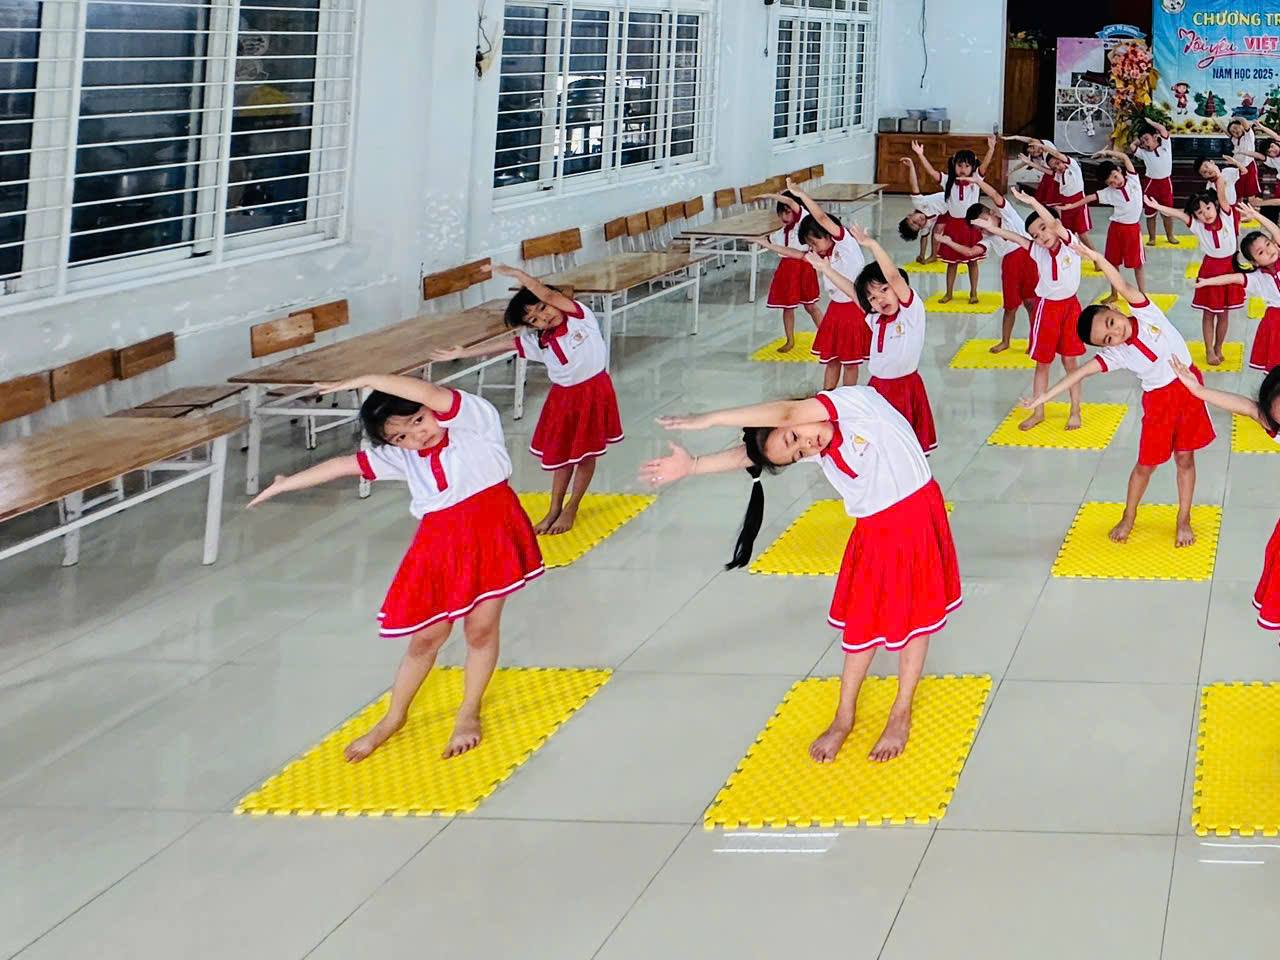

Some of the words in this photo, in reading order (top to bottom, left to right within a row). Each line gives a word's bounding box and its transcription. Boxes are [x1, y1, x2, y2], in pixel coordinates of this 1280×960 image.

[1192, 10, 1261, 26] CHƯƠNG
[1198, 37, 1237, 69] yêu
[1244, 35, 1278, 54] VIỆT
[1234, 68, 1251, 81] HỌC
[1253, 68, 1274, 79] 2025
